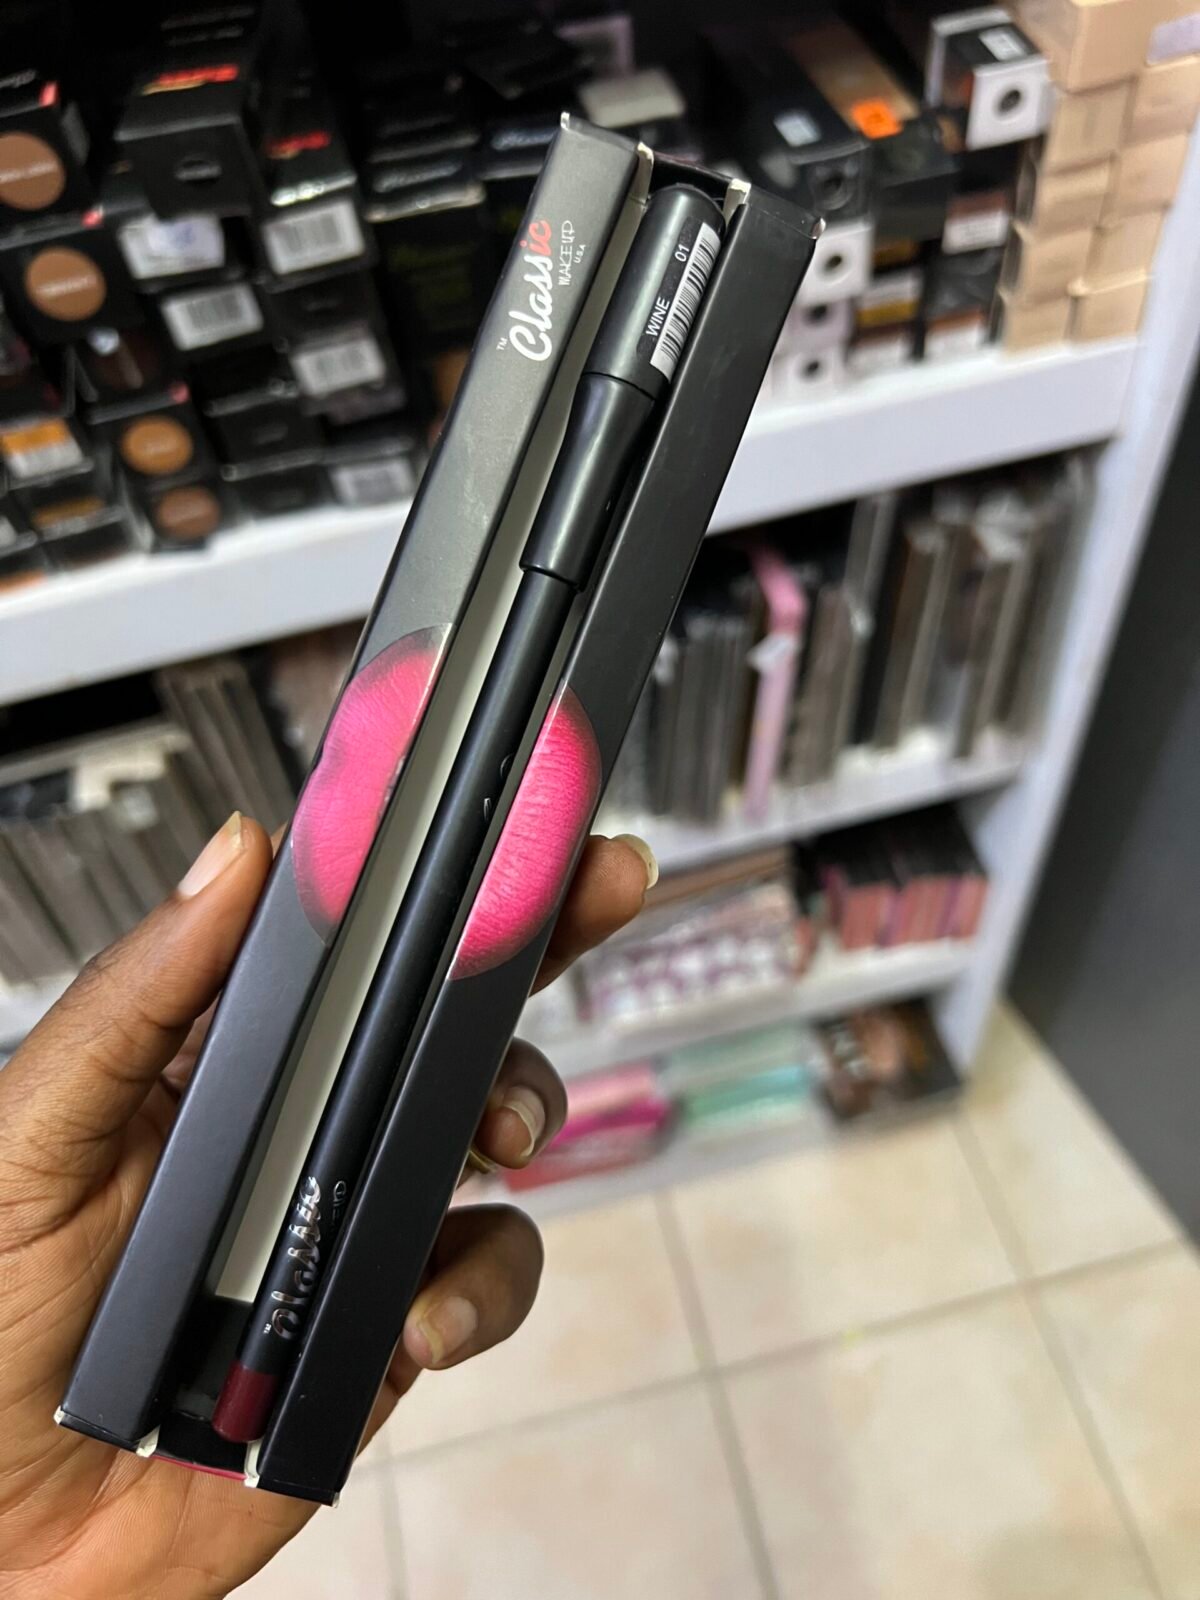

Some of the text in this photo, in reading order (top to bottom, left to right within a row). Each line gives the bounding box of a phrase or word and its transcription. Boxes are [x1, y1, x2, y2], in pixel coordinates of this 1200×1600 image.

[508, 220, 554, 362] Classic
[645, 243, 690, 337] WINE 01
[495, 337, 508, 351] TM
